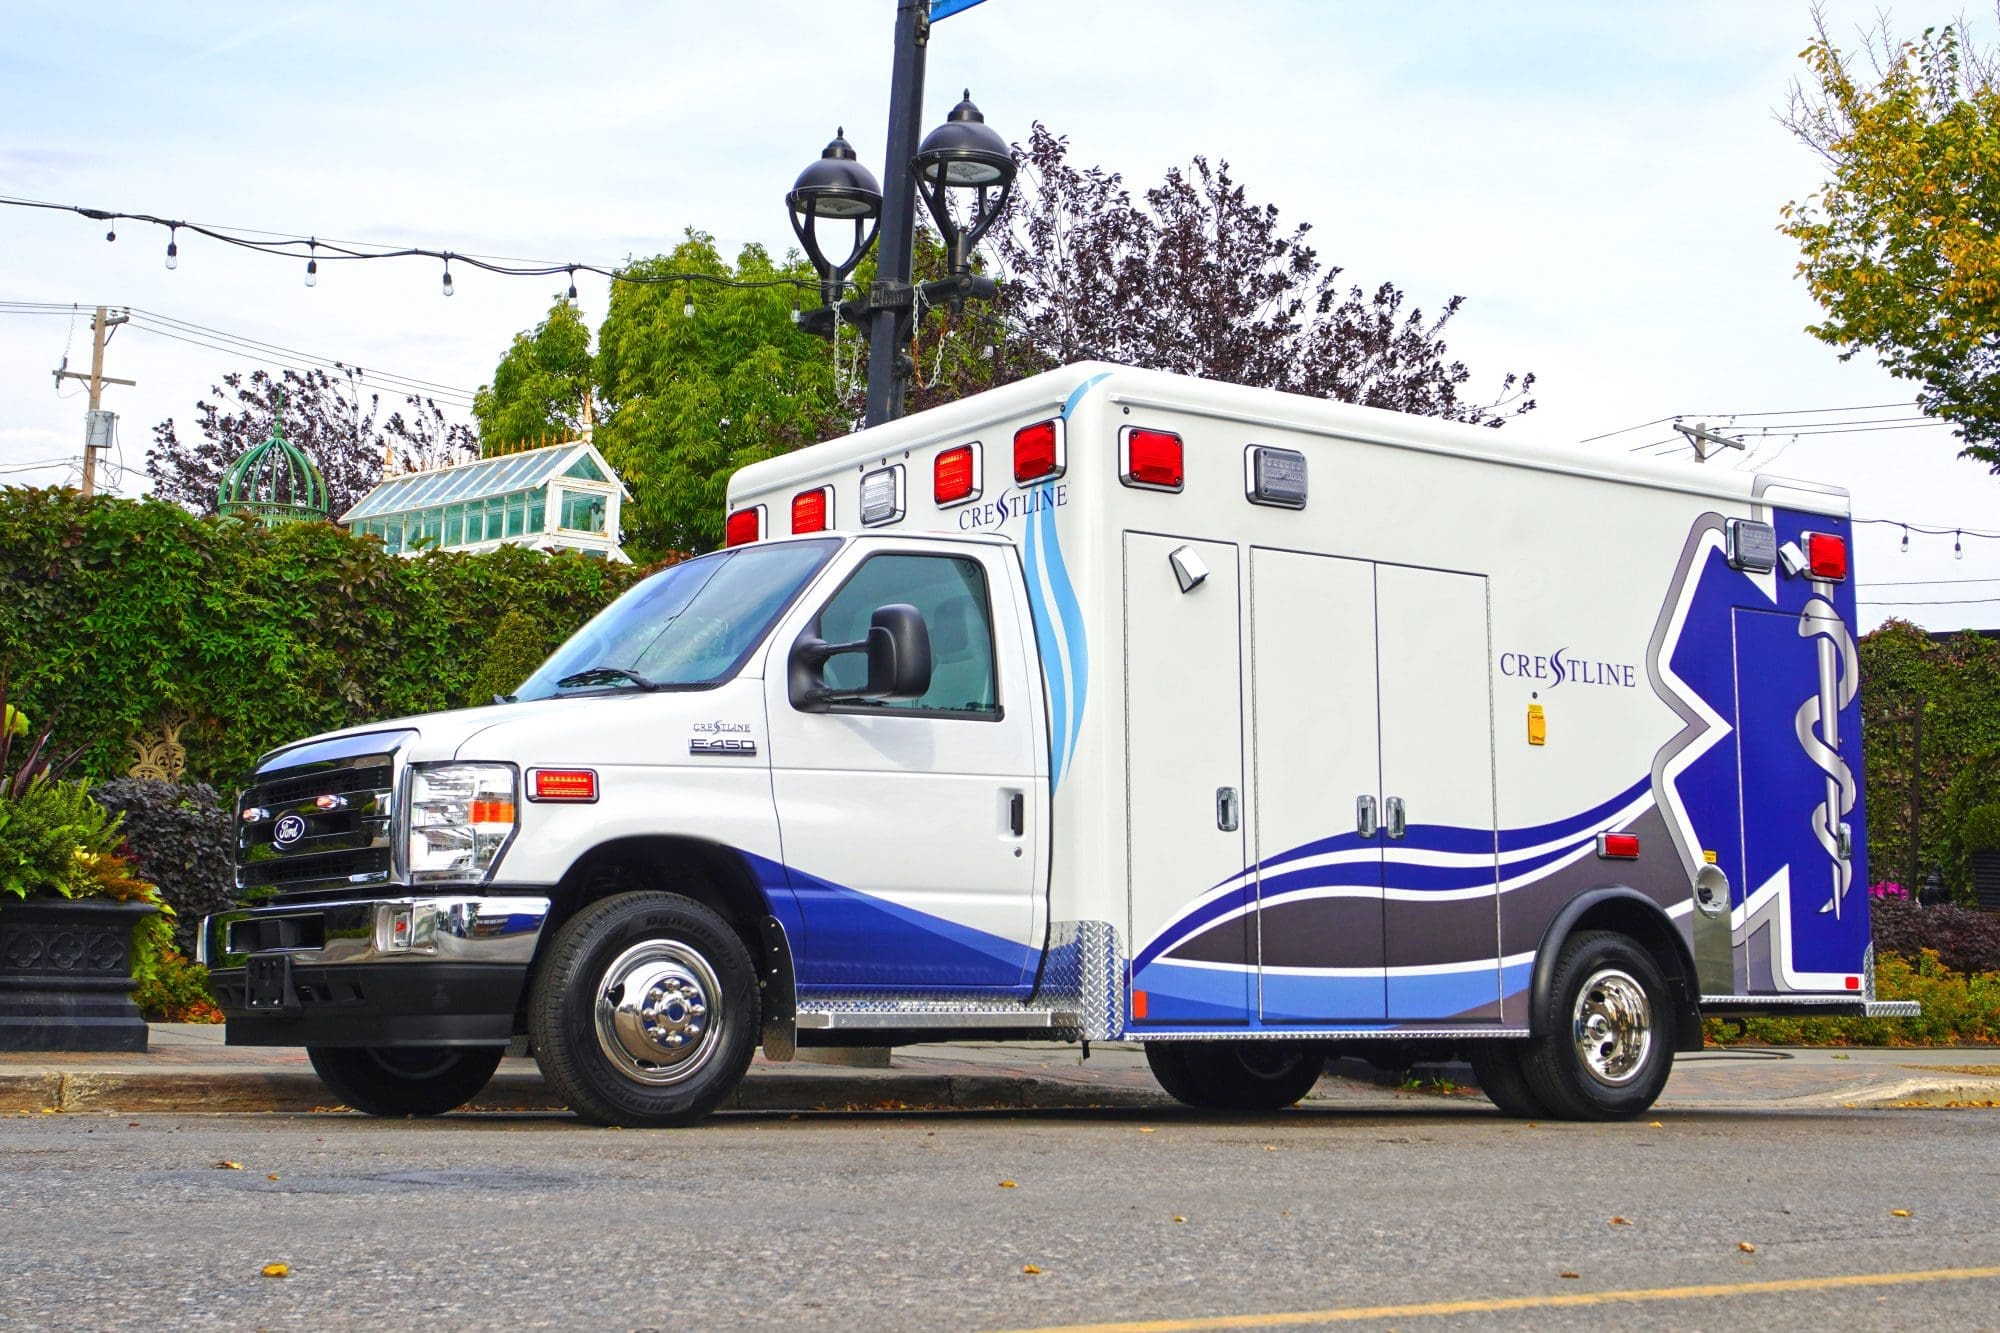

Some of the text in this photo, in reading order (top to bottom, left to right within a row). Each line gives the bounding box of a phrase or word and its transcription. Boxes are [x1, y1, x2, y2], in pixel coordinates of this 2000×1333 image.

[959, 484, 1067, 531] CRESTLINE
[1500, 646, 1637, 689] CRESTLINE
[693, 720, 751, 735] CRESTLINE
[279, 819, 299, 839] Ford
